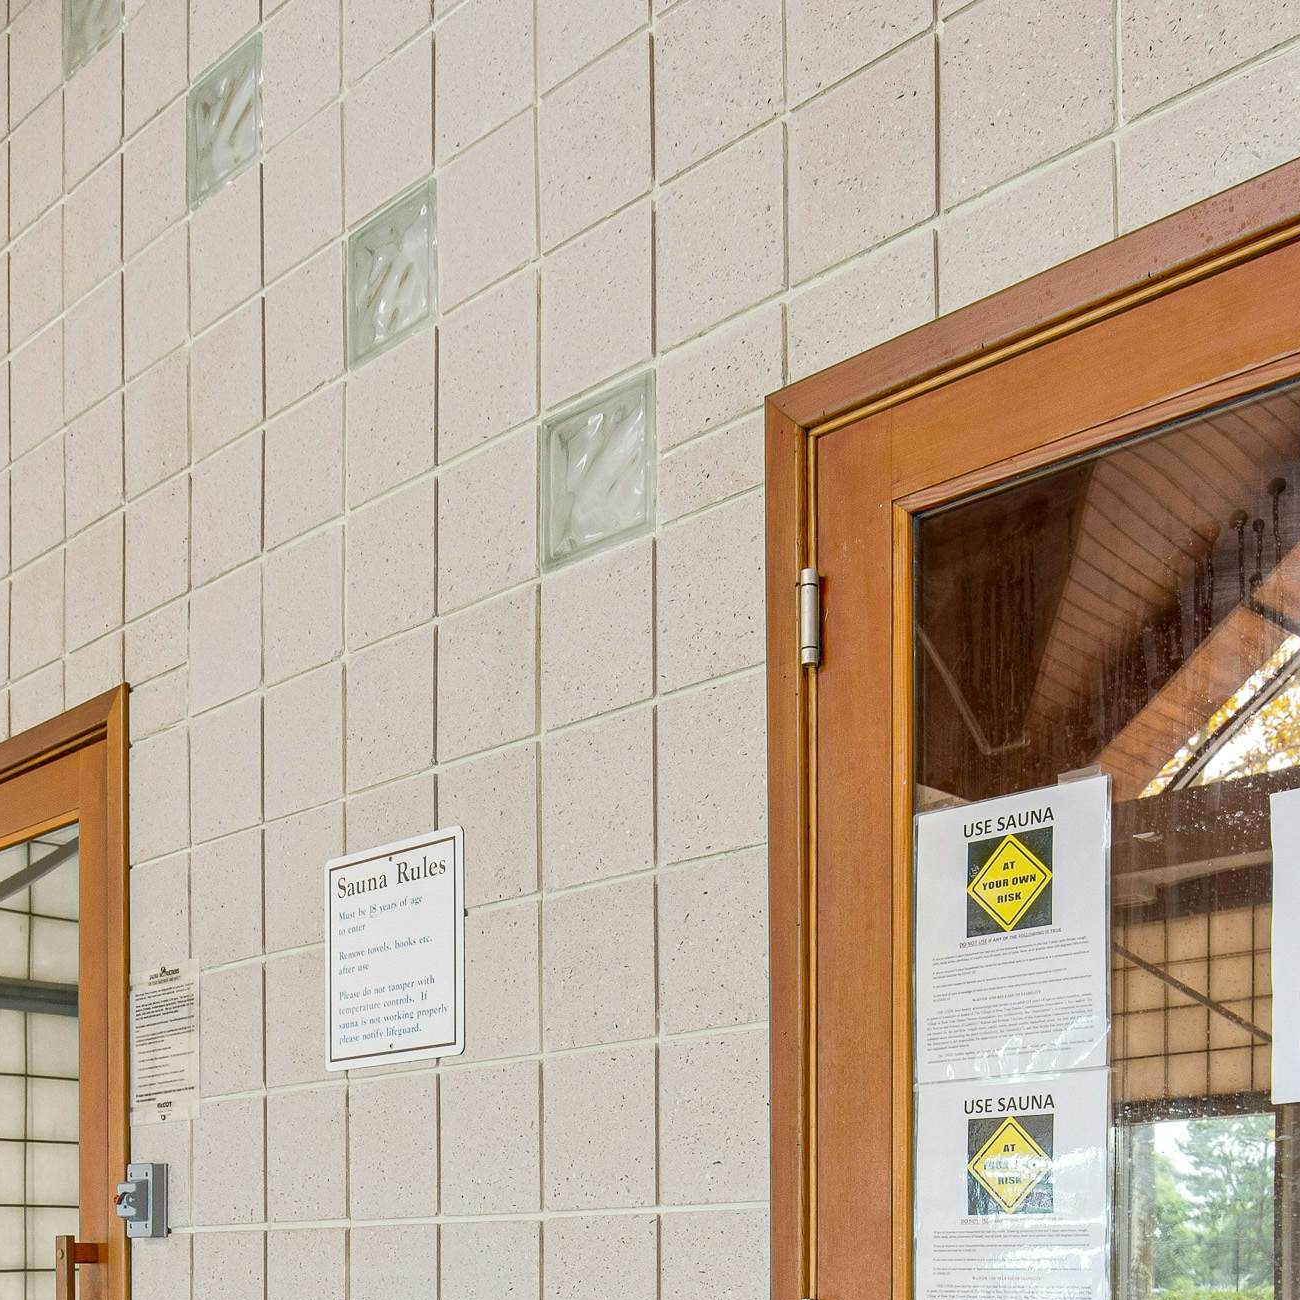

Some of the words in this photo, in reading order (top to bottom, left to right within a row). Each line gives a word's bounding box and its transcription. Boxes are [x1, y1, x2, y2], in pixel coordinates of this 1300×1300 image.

[963, 818, 992, 838] USE
[996, 805, 1054, 832] SAUNA
[1002, 860, 1015, 871] AT
[337, 873, 388, 899] Sauna
[396, 856, 446, 884] Rules
[982, 878, 1008, 891] YOUR
[1011, 873, 1036, 885] OWN
[338, 909, 355, 921] Must
[358, 907, 366, 917] be
[379, 901, 397, 913] years
[400, 896, 407, 907] of
[410, 895, 423, 905] age
[996, 891, 1021, 904] RISK
[338, 928, 346, 936] to
[347, 924, 366, 935] enter
[339, 950, 365, 960] Remove
[367, 942, 392, 955] towels,
[394, 937, 417, 949] books
[338, 965, 355, 975] after
[357, 963, 369, 972] use
[339, 990, 360, 1001] Please
[362, 987, 372, 997] do
[374, 986, 385, 995] not
[388, 979, 415, 992] tamper
[417, 974, 435, 986] with
[420, 990, 428, 1001] If
[339, 1018, 358, 1029] sauna
[361, 1015, 367, 1025] is
[369, 1014, 381, 1024] not
[384, 1010, 414, 1023] working
[416, 1003, 448, 1020] properly
[339, 1033, 360, 1045] please
[362, 1029, 383, 1041] notify
[386, 1023, 422, 1037] lifeguard.
[963, 1097, 992, 1115] USE
[997, 1093, 1054, 1112] SAUNA
[1002, 1143, 1015, 1152] AT
